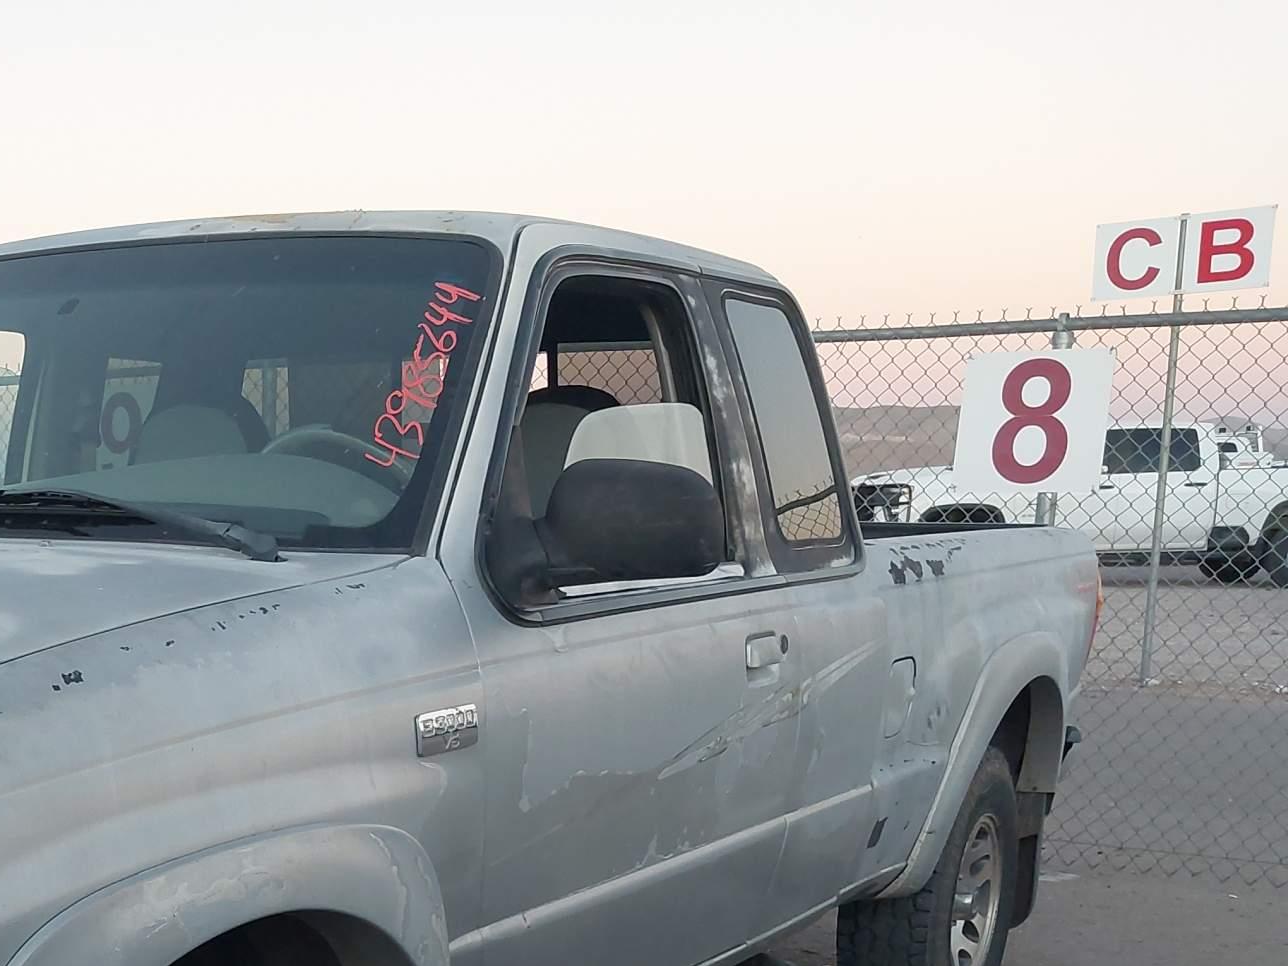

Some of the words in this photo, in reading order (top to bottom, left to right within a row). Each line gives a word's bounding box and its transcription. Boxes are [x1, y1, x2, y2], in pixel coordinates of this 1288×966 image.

[1106, 227, 1163, 291] C
[1196, 217, 1257, 285] B
[365, 281, 481, 467] 43985644
[991, 357, 1073, 485] 8
